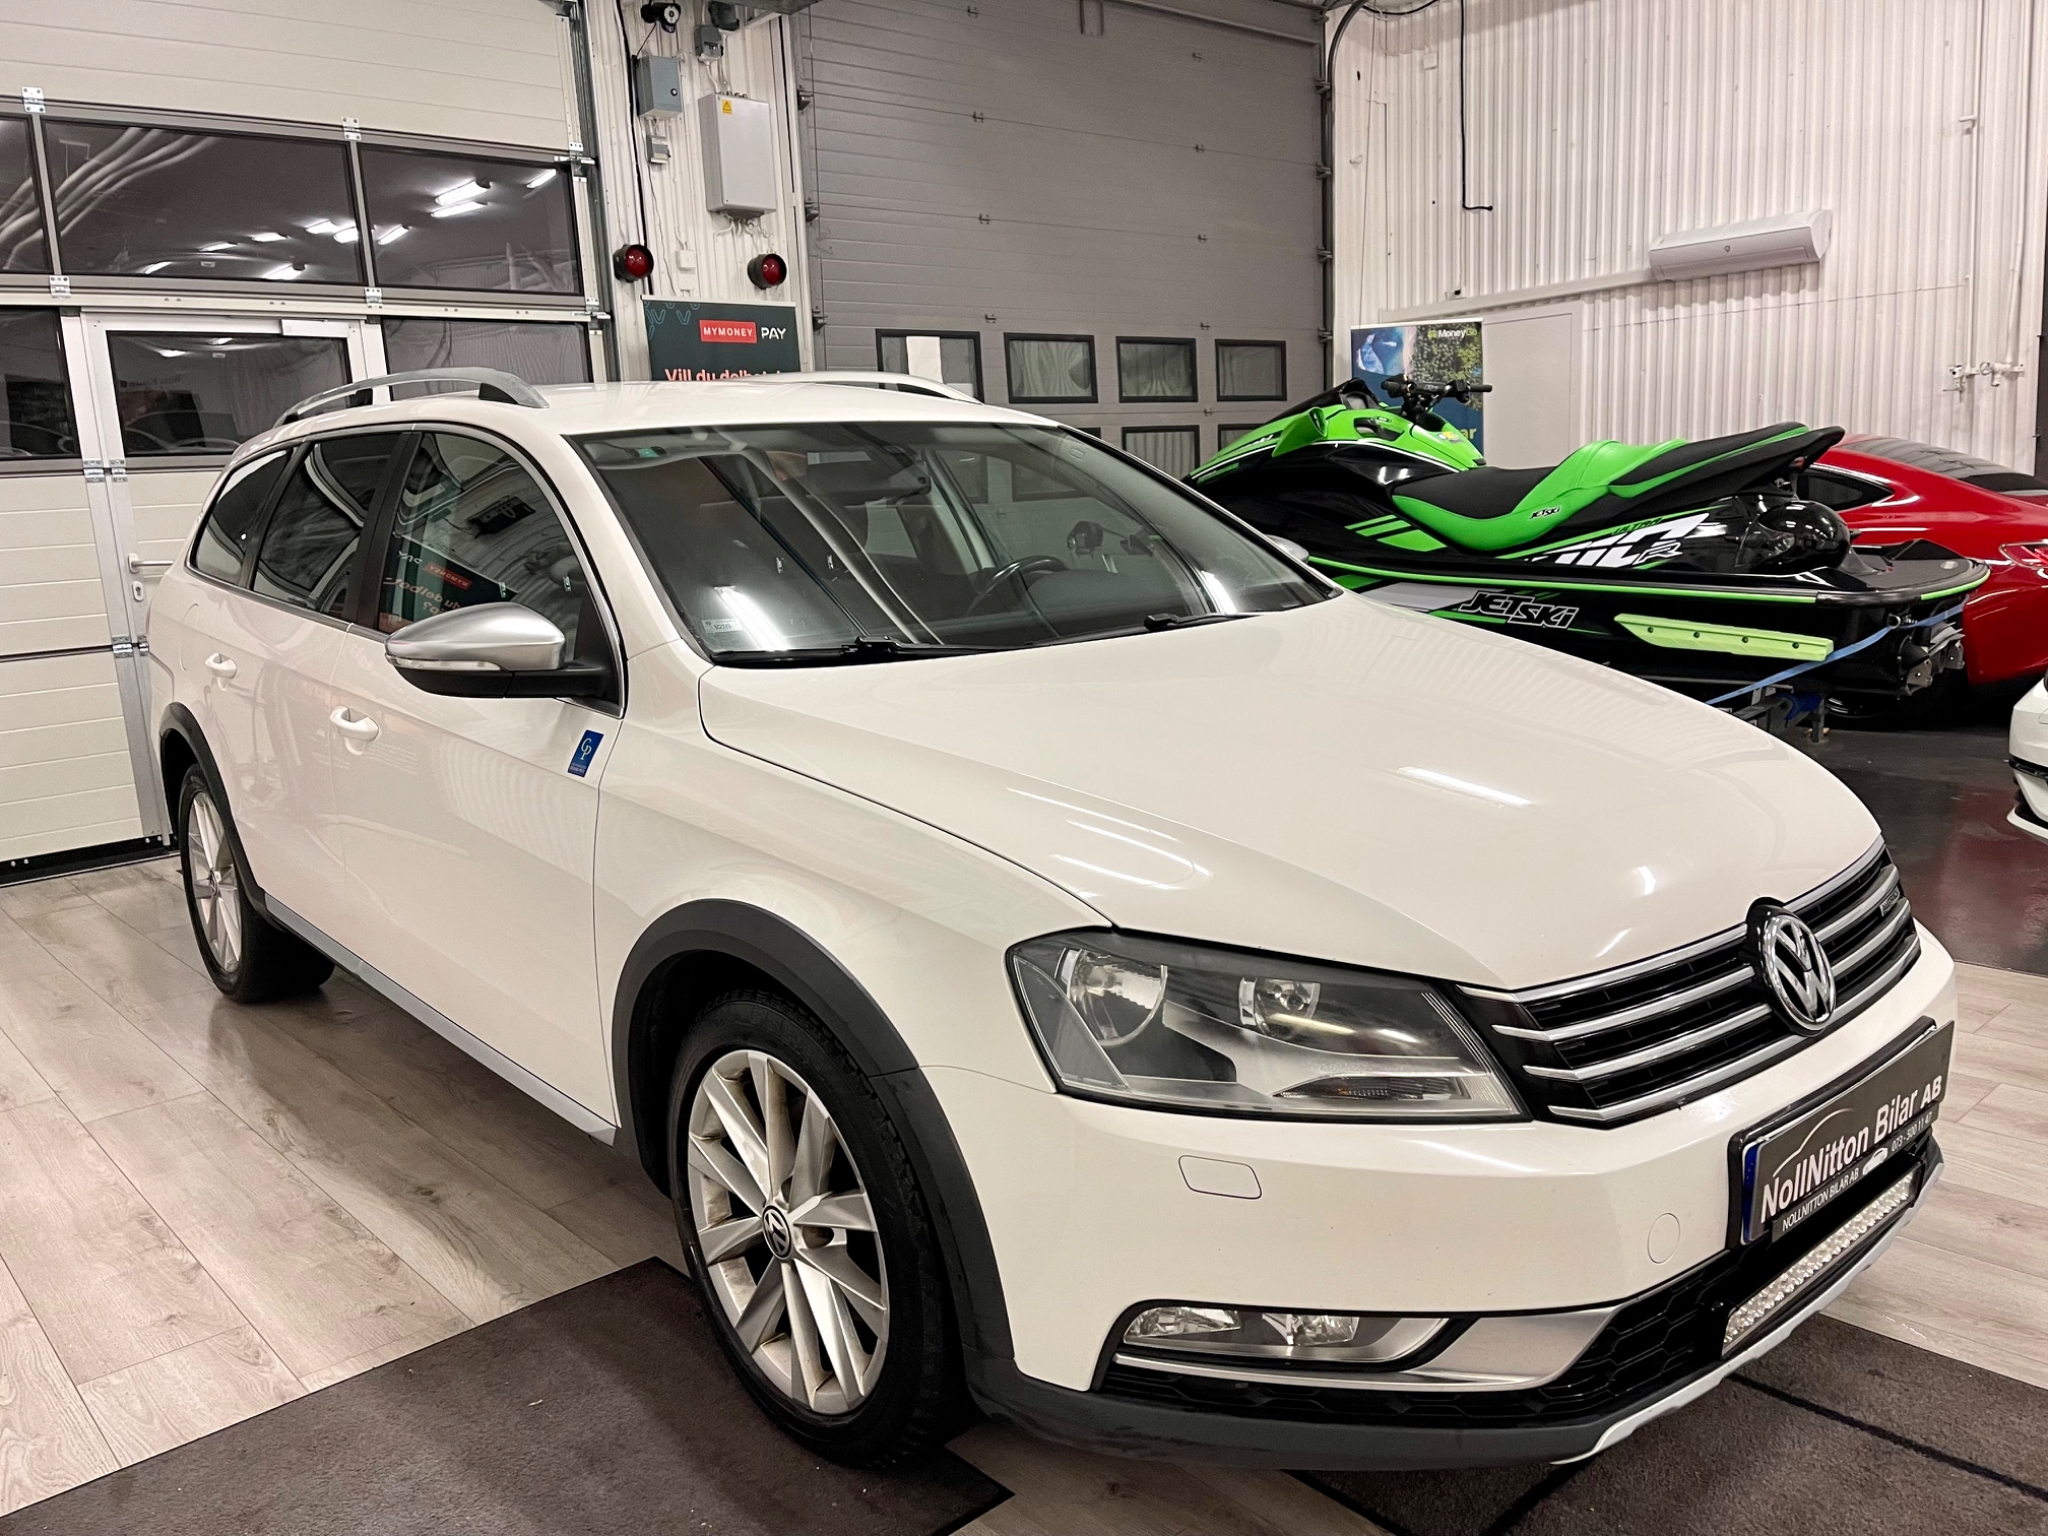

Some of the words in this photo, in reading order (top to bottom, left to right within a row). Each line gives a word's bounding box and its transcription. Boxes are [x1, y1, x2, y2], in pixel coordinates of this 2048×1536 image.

[703, 326, 753, 337] MYMONEY
[761, 327, 787, 340] PAY
[664, 368, 692, 382] Vill
[1611, 517, 1664, 536] ULTRA
[1761, 1126, 1869, 1223] NollNitton
[1874, 1089, 1918, 1146] Bilar
[1920, 1075, 1942, 1109] AB
[1783, 1189, 1829, 1232] NOLLNITTON
[1829, 1174, 1849, 1198] BILAR
[1849, 1167, 1860, 1183] AB
